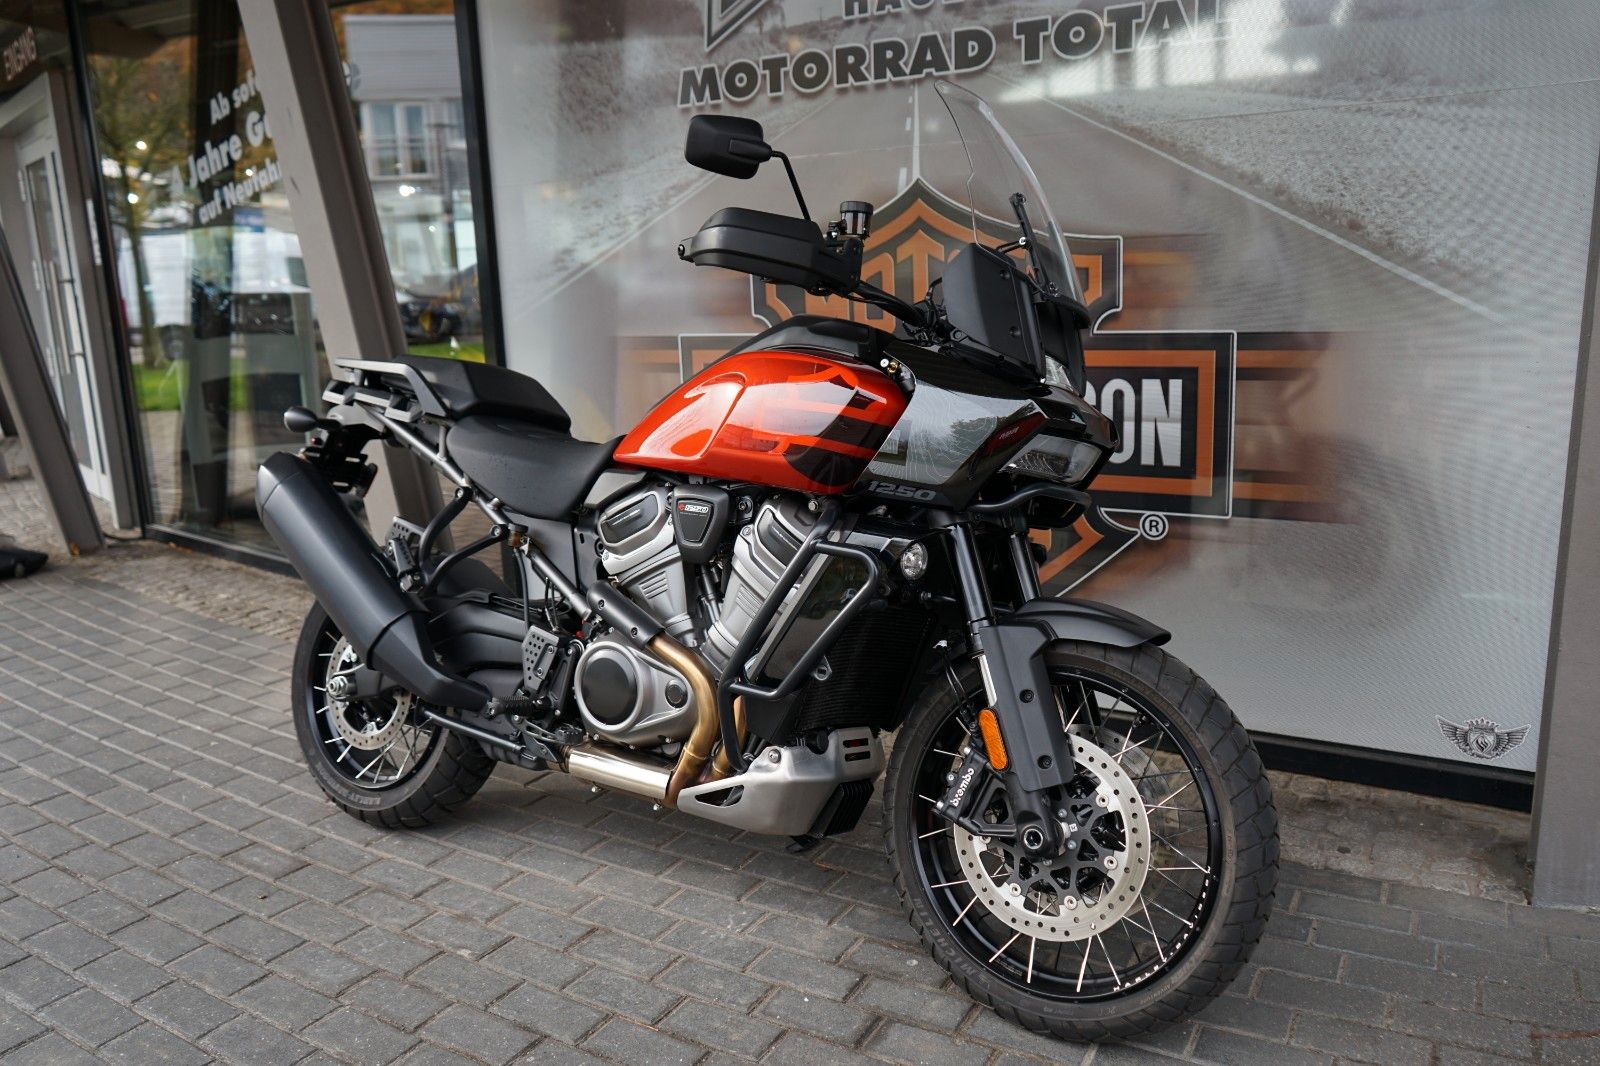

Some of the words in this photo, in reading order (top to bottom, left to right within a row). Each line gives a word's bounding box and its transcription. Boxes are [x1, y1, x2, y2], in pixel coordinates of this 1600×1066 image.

[678, 26, 996, 108] MOTORRAD
[210, 92, 230, 125] Ab
[188, 134, 243, 188] Jahre
[199, 188, 222, 224] auf
[1084, 378, 1183, 467] ON
[868, 480, 937, 501] 1250
[950, 767, 975, 807] brembo
